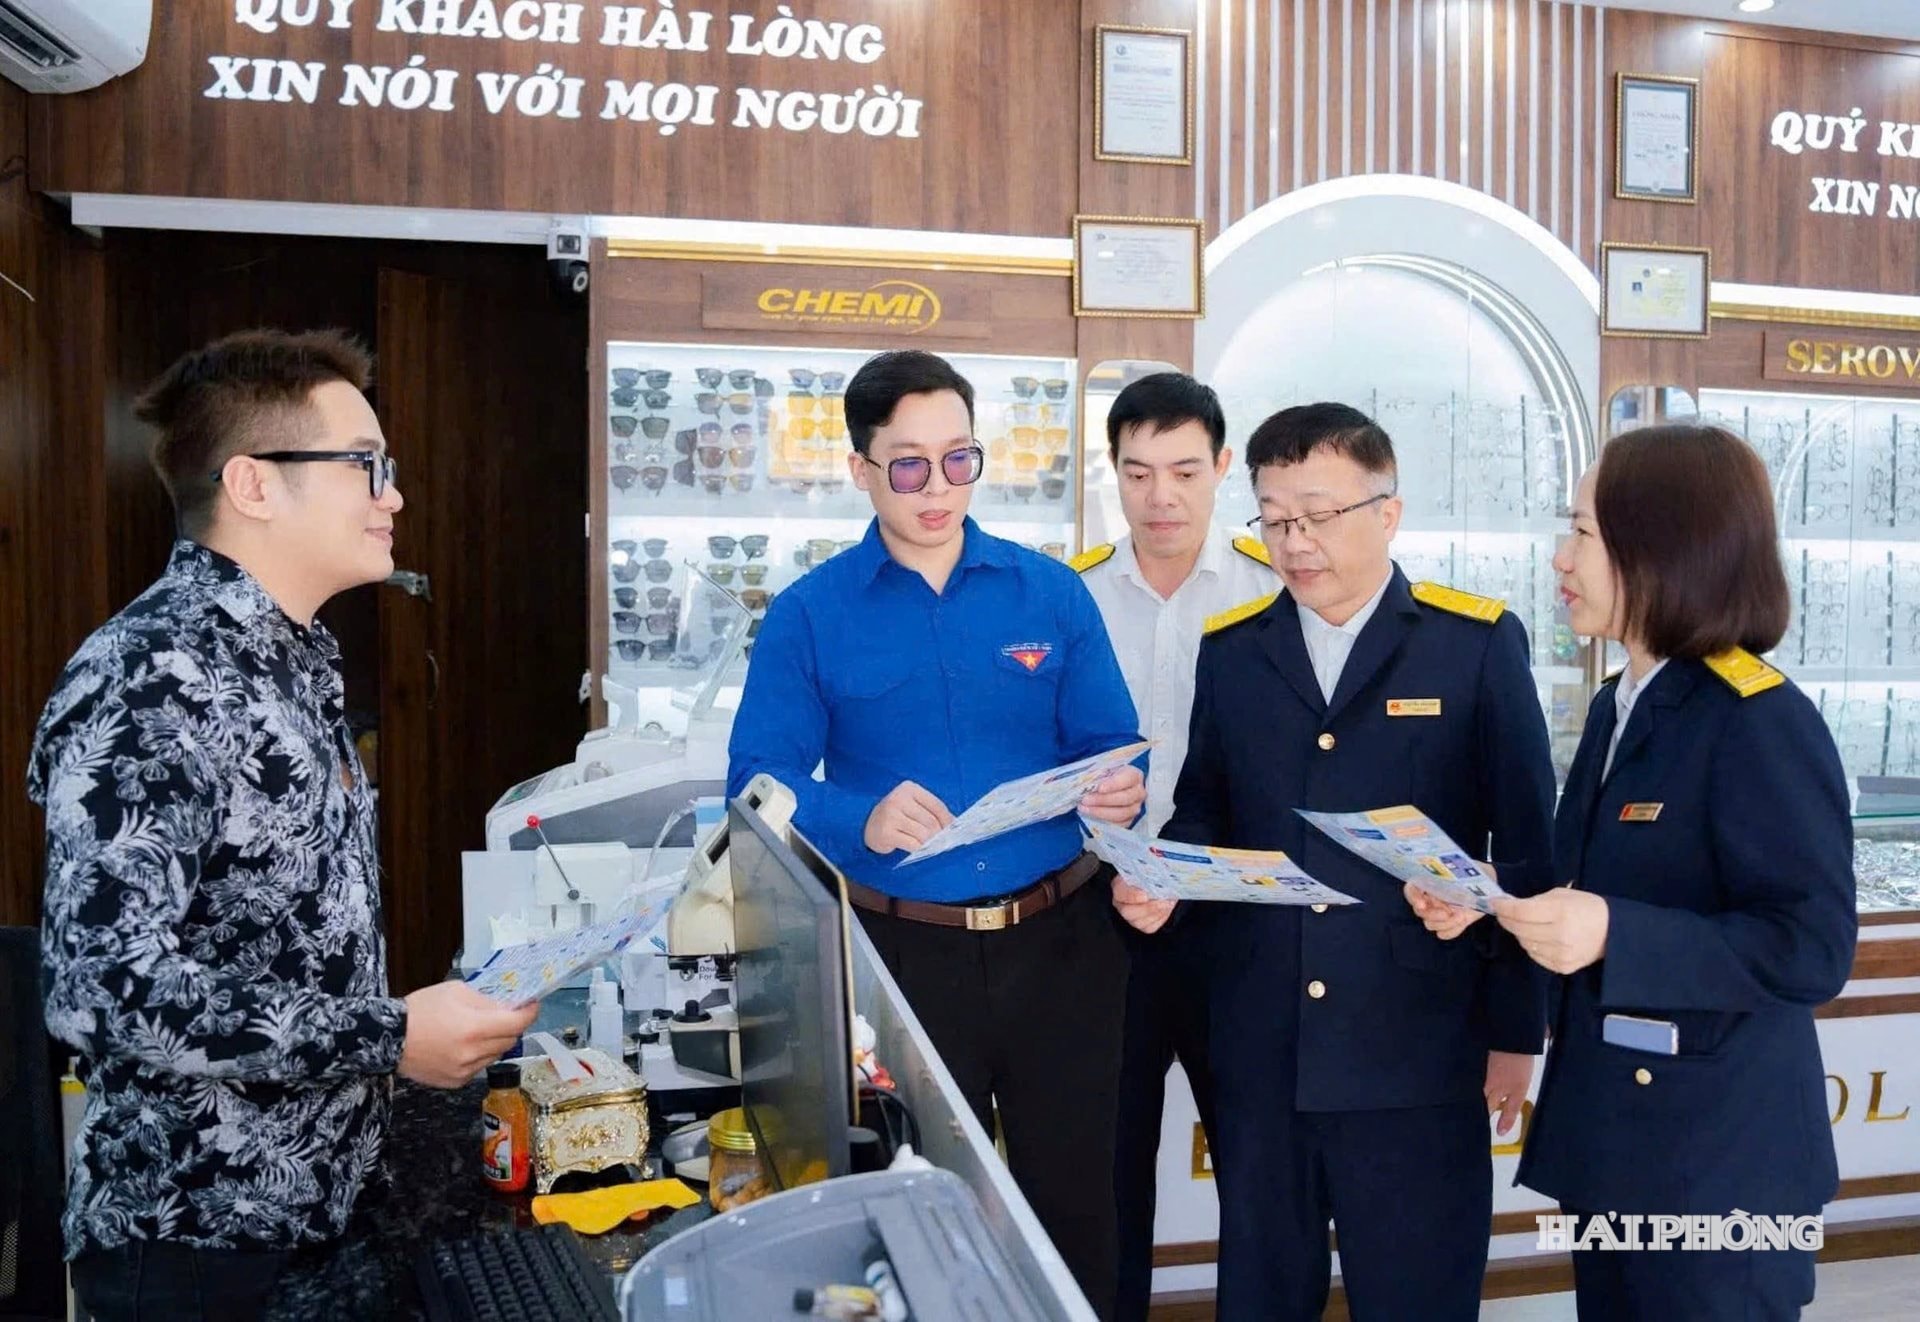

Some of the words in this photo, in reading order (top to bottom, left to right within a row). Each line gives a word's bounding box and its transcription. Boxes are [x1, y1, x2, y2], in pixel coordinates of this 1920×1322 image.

[599, 0, 713, 52] HÀI
[726, 5, 886, 64] LÒNG
[204, 56, 327, 104] XIN
[338, 55, 459, 111] NÓI
[476, 63, 585, 119] VỚI
[599, 79, 720, 136] MỌI
[731, 84, 924, 138] NGƯỜI
[1771, 107, 1867, 155] QUÝ
[1877, 121, 1920, 159] K
[1808, 177, 1880, 217] XIN
[1887, 184, 1920, 220] N
[757, 288, 927, 318] CHEMI
[1785, 339, 1920, 378] SEROV
